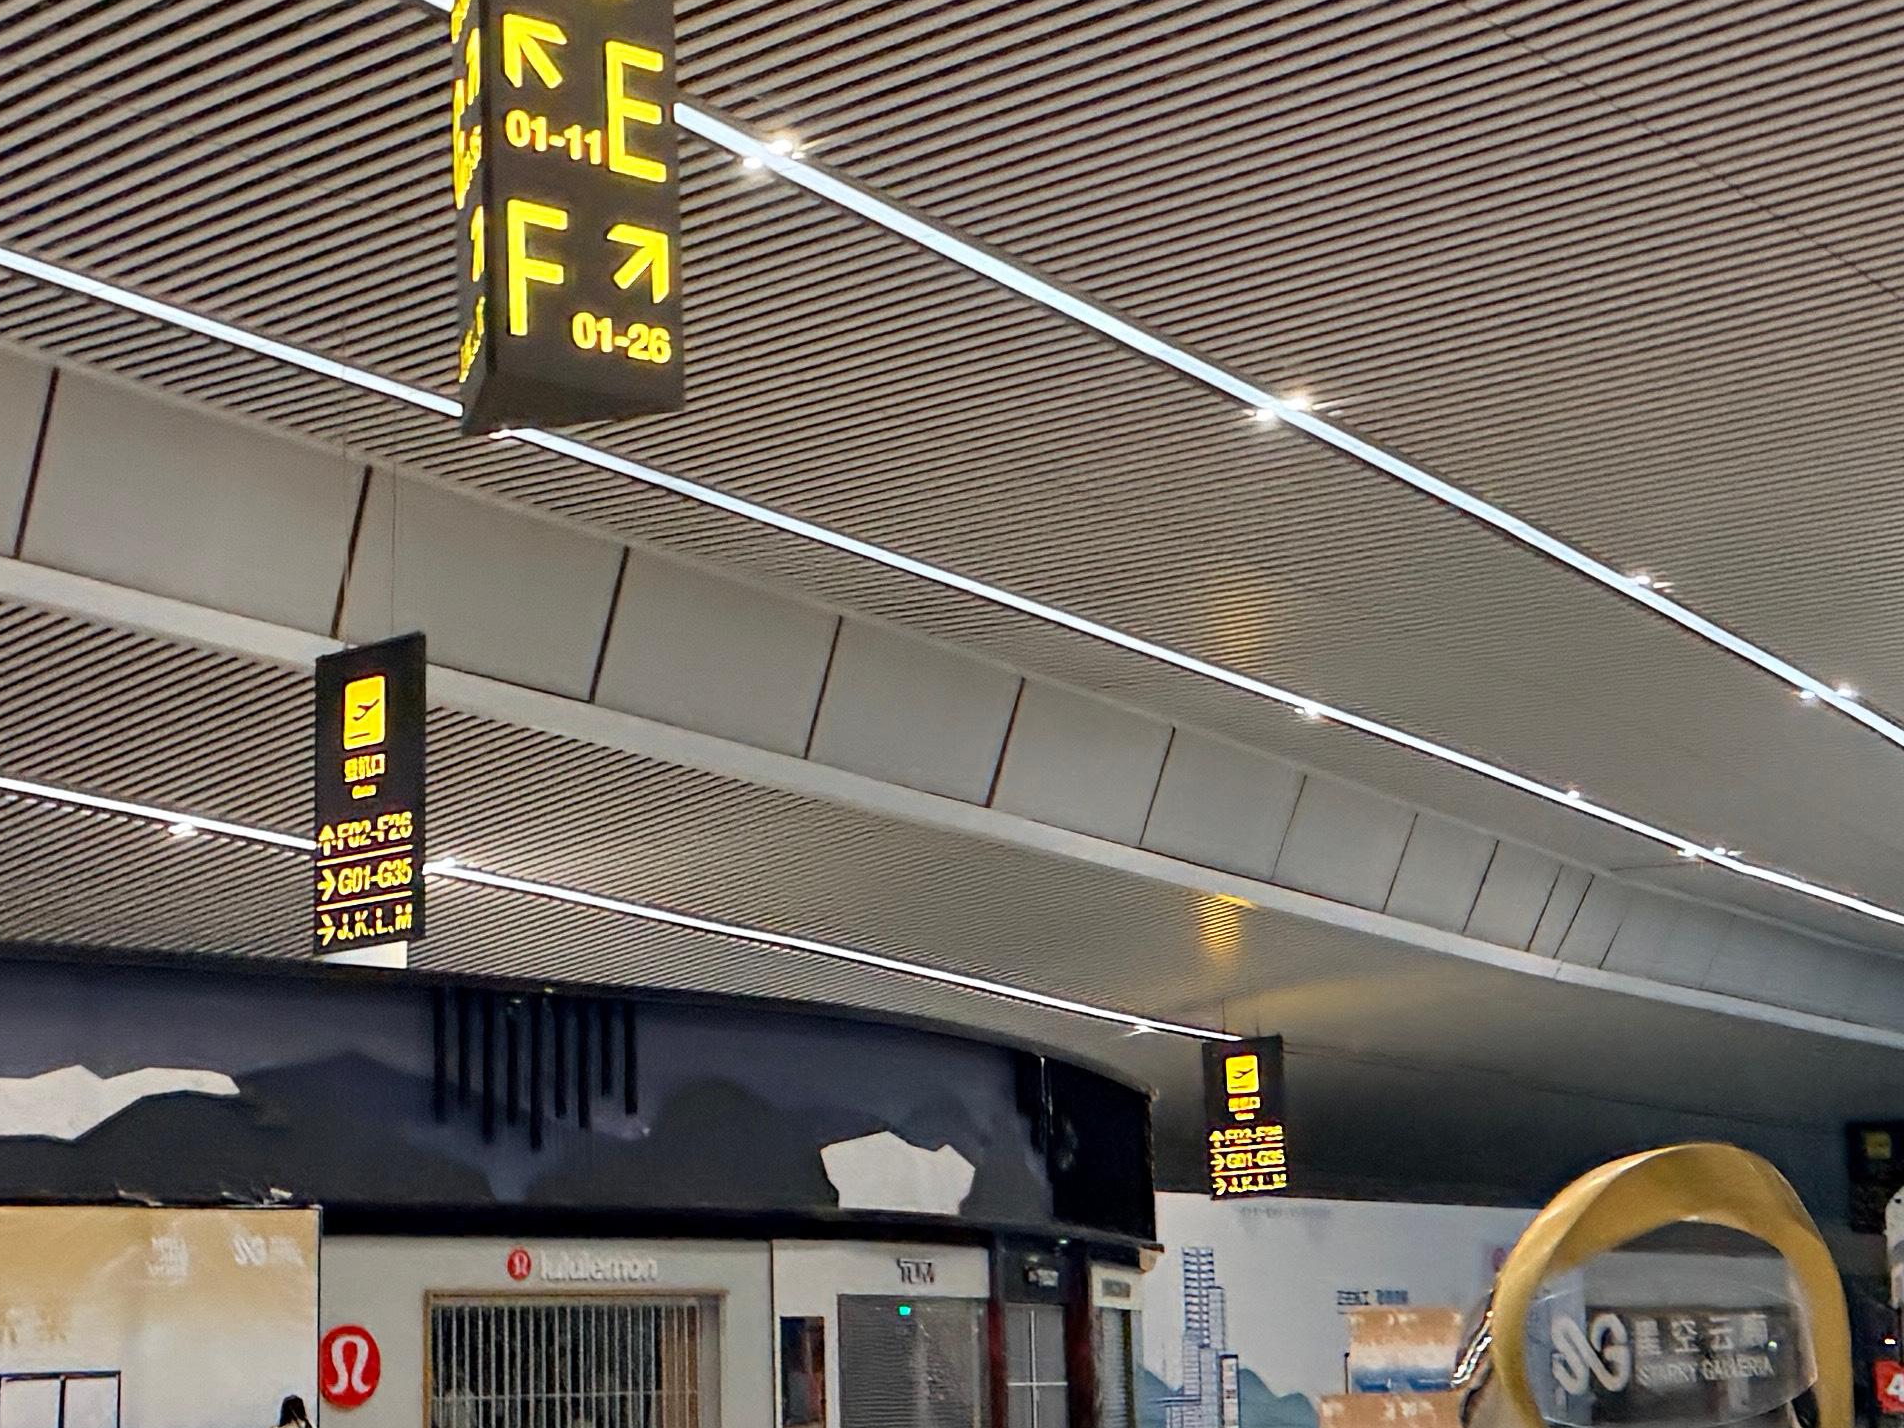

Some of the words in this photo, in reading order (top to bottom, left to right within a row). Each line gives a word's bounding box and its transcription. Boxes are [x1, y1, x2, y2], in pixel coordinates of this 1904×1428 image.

[504, 108, 603, 167] 01-11
[604, 39, 667, 183] E
[507, 197, 568, 337] F
[571, 310, 671, 365] 01-26
[337, 811, 413, 851] F02-F26
[337, 857, 413, 896] G01-G35
[539, 1250, 658, 1283] lululemon
